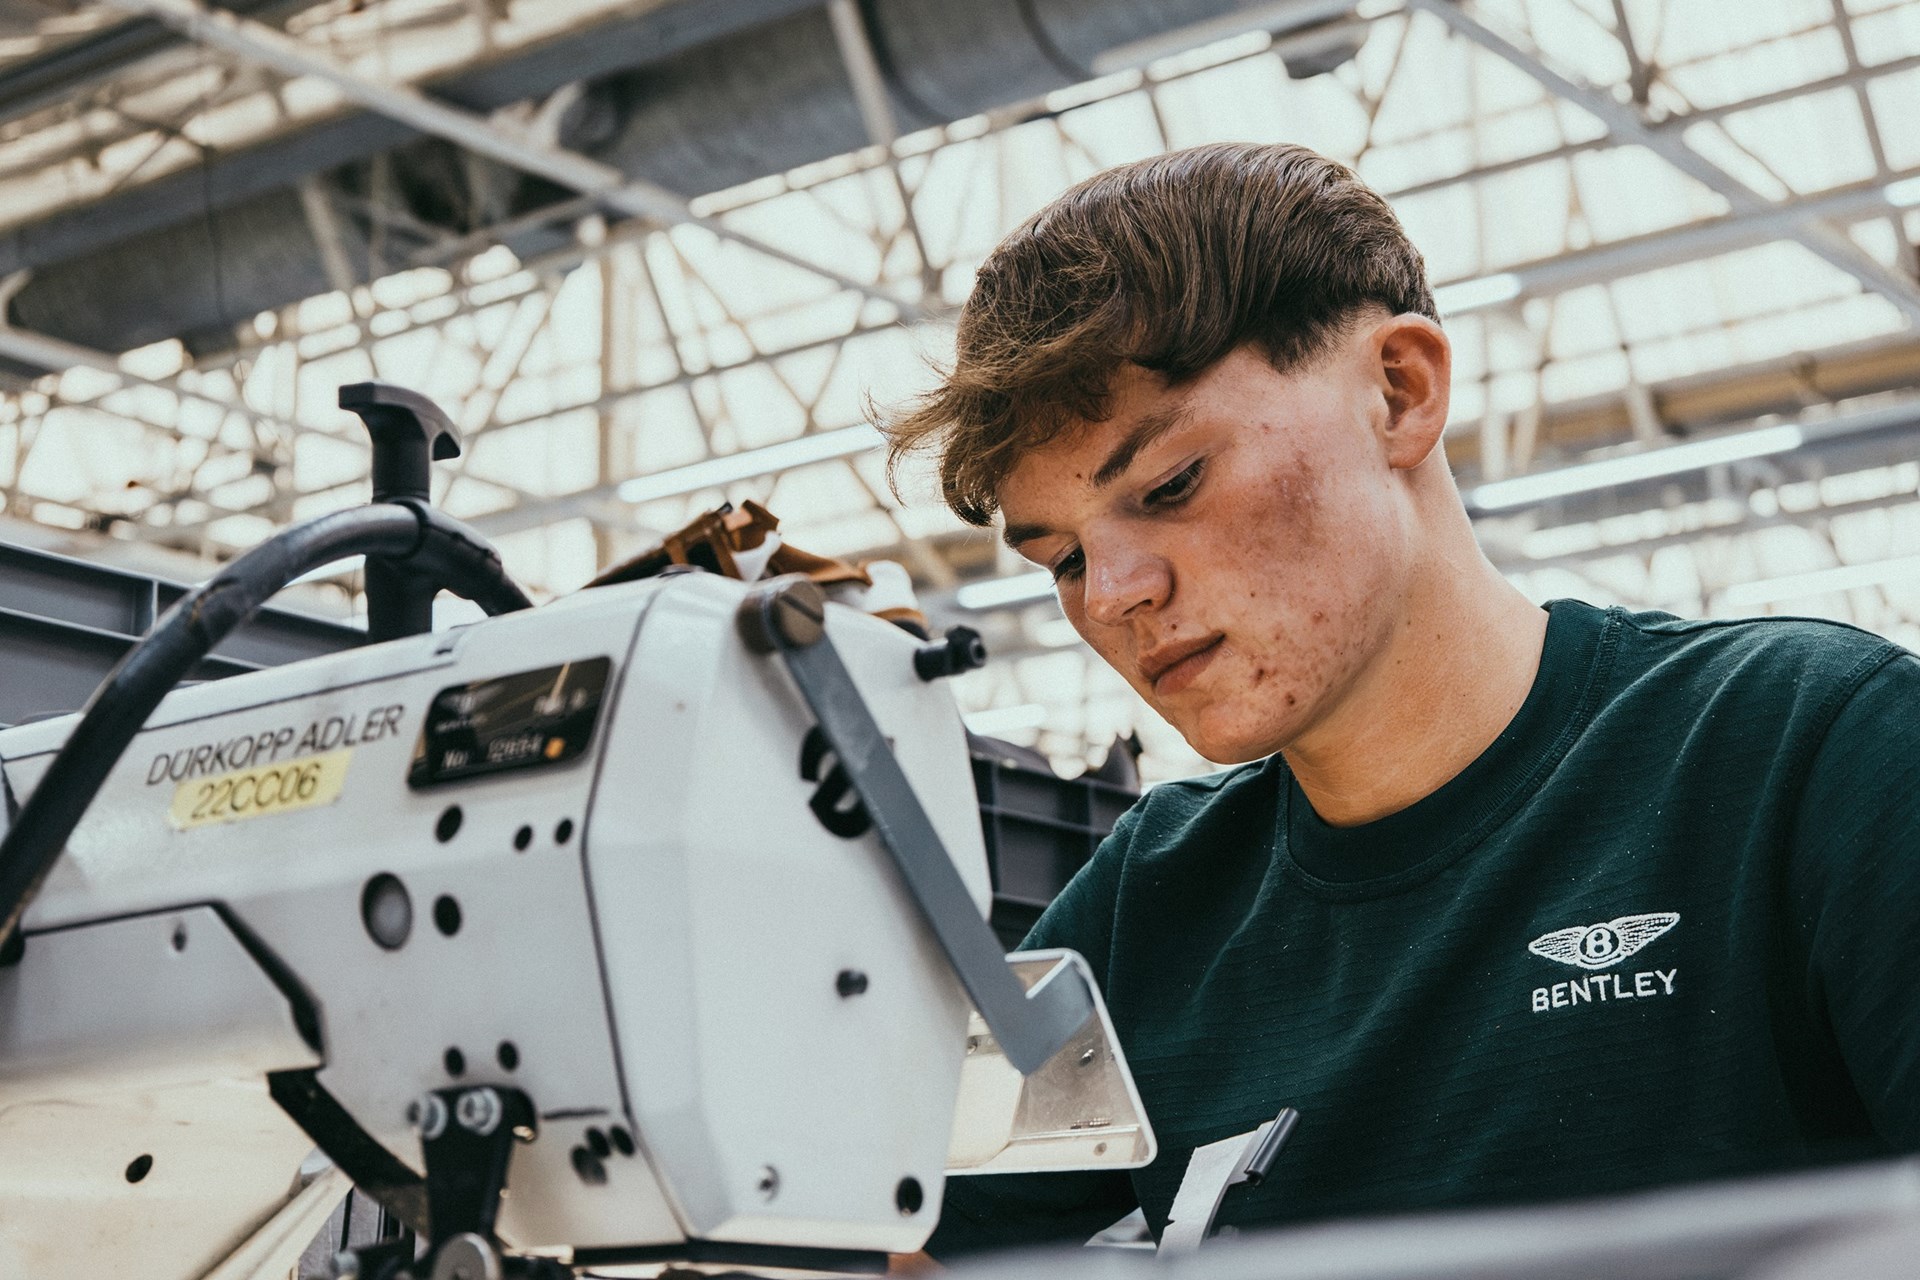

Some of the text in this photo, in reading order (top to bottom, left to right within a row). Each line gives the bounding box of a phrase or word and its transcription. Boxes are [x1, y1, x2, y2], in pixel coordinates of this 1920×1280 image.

[293, 704, 405, 757] ADLER
[191, 762, 321, 819] 22CC06
[1585, 928, 1613, 958] B
[1532, 968, 1677, 1013] BENTLEY
